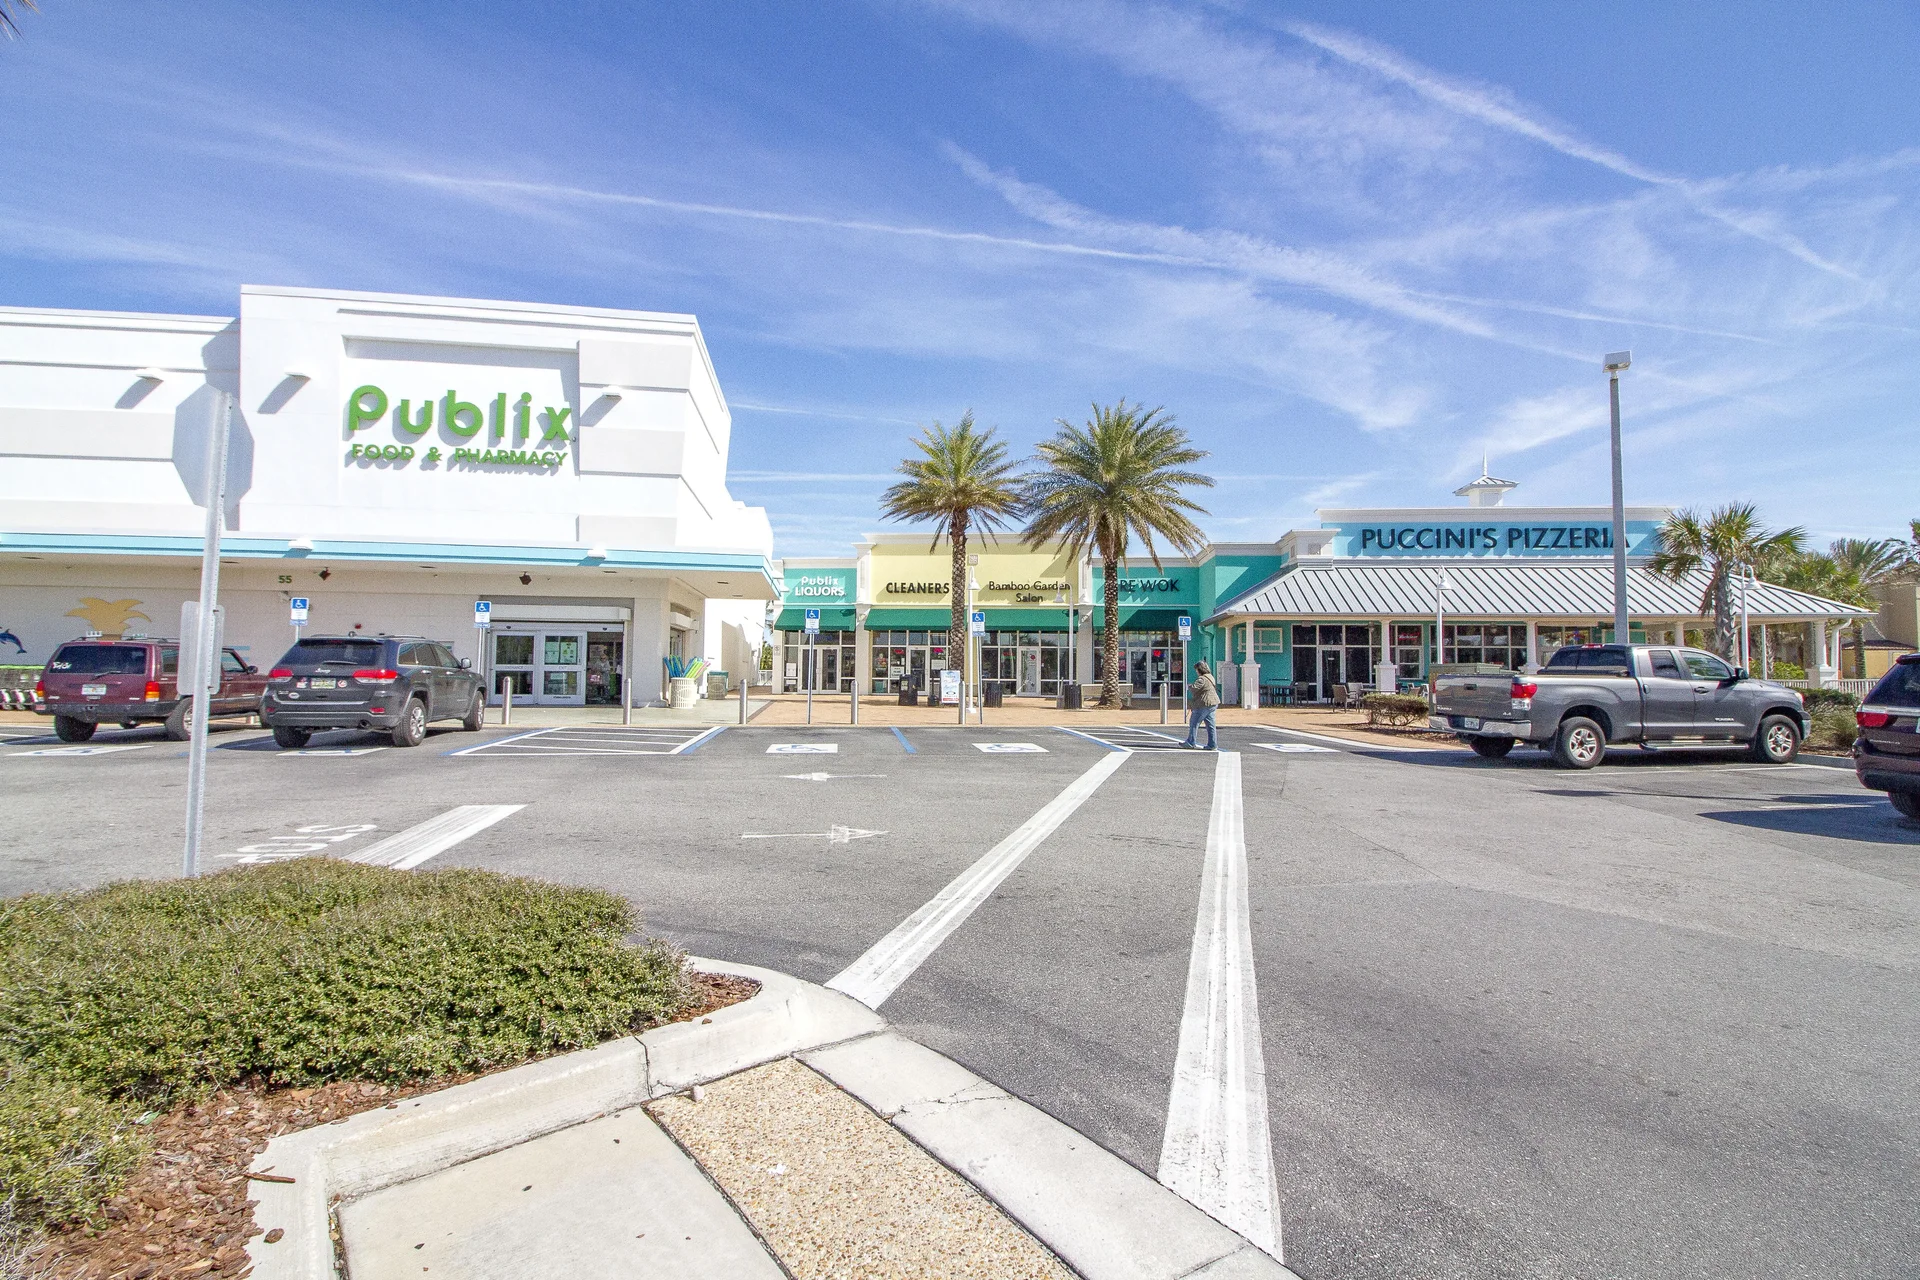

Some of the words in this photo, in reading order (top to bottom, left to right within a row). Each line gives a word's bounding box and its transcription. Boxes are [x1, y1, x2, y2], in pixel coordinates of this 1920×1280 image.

[349, 384, 572, 441] Publix
[352, 443, 415, 461] FOOD
[428, 446, 442, 462] &
[455, 447, 568, 467] PHARMACY
[1361, 527, 1498, 549] PUCCINI'S
[278, 574, 293, 584] 55
[801, 575, 839, 586] Publix
[885, 582, 950, 594] CLEANERS
[988, 580, 1031, 591] Bamboo
[1033, 580, 1071, 591] Garden
[1119, 579, 1136, 593] RE
[1140, 579, 1181, 592] WOK
[794, 586, 845, 597] LIQUORS
[1015, 592, 1044, 603] Salon
